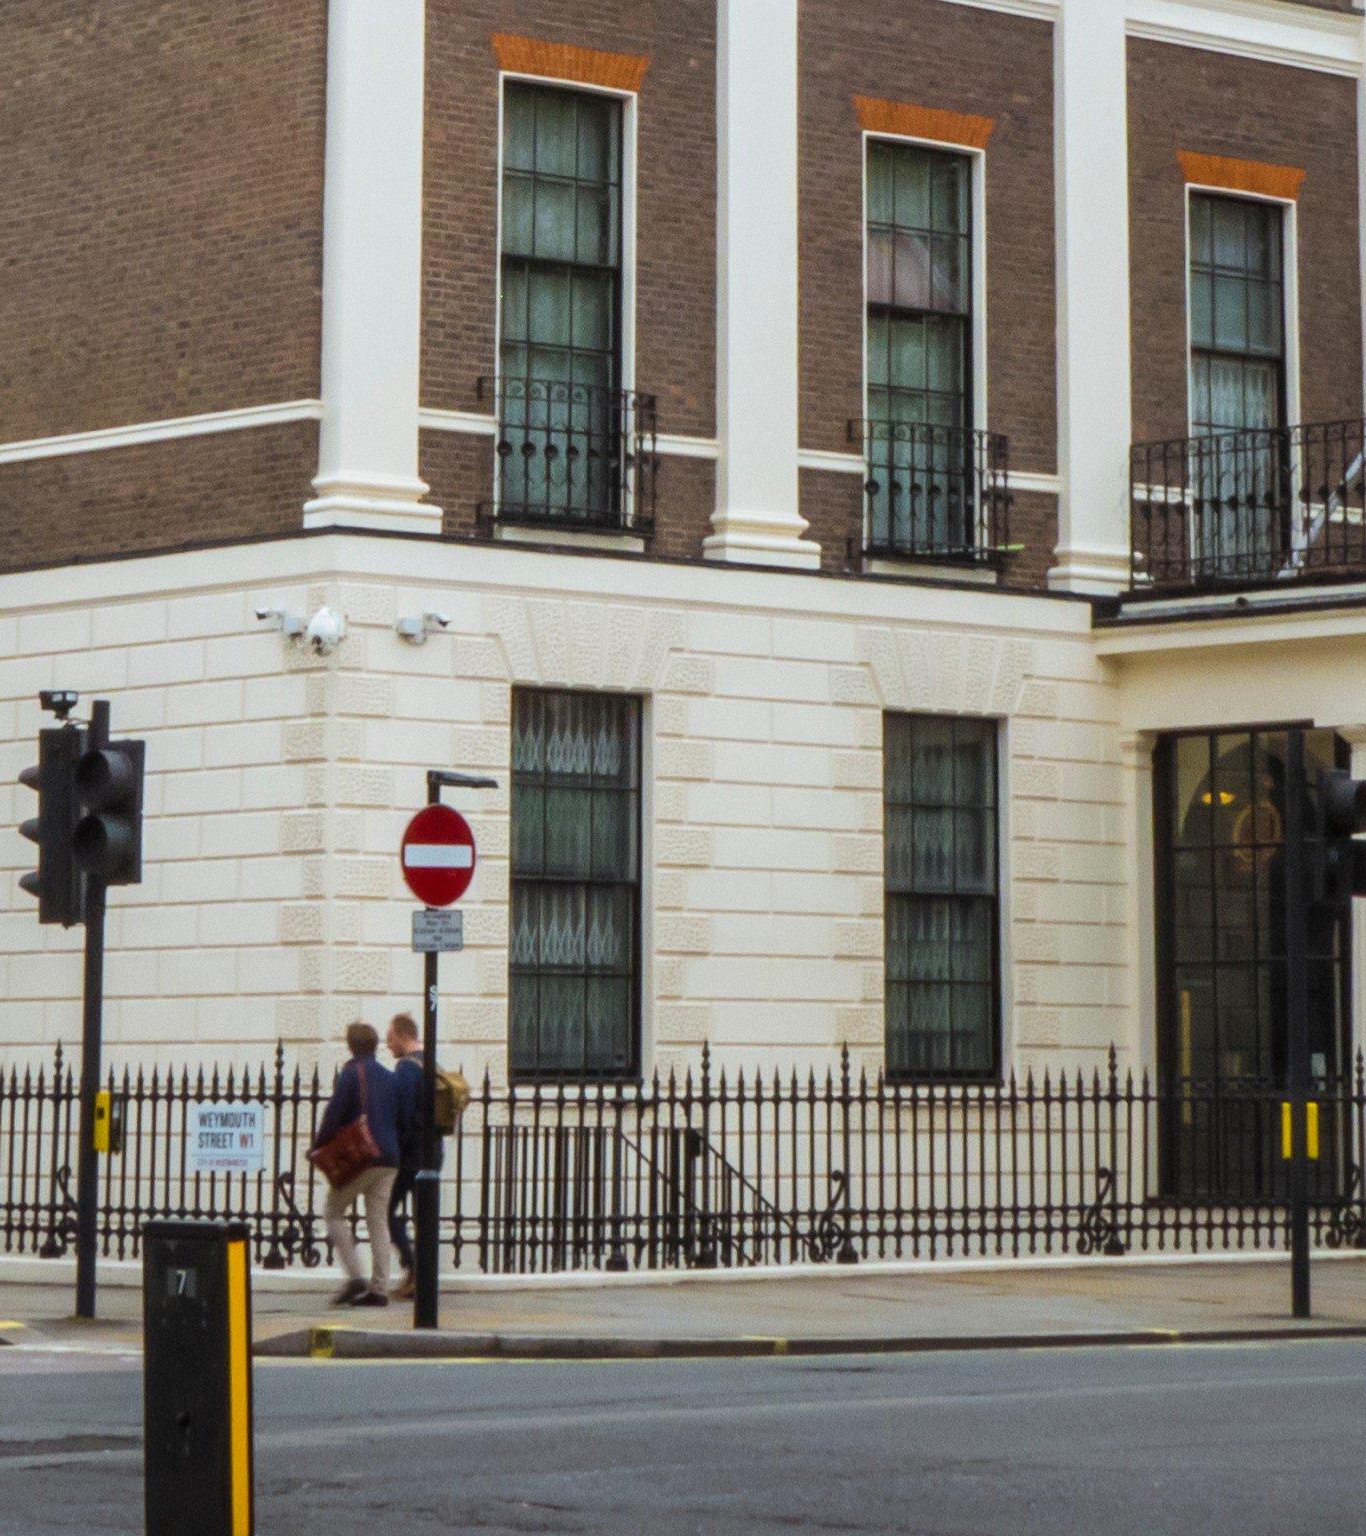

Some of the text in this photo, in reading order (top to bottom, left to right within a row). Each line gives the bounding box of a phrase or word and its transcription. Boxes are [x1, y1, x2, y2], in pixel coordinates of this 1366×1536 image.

[198, 1111, 256, 1128] WEYMOUTH
[198, 1132, 254, 1149] STREET W1
[176, 1269, 187, 1295] 7
